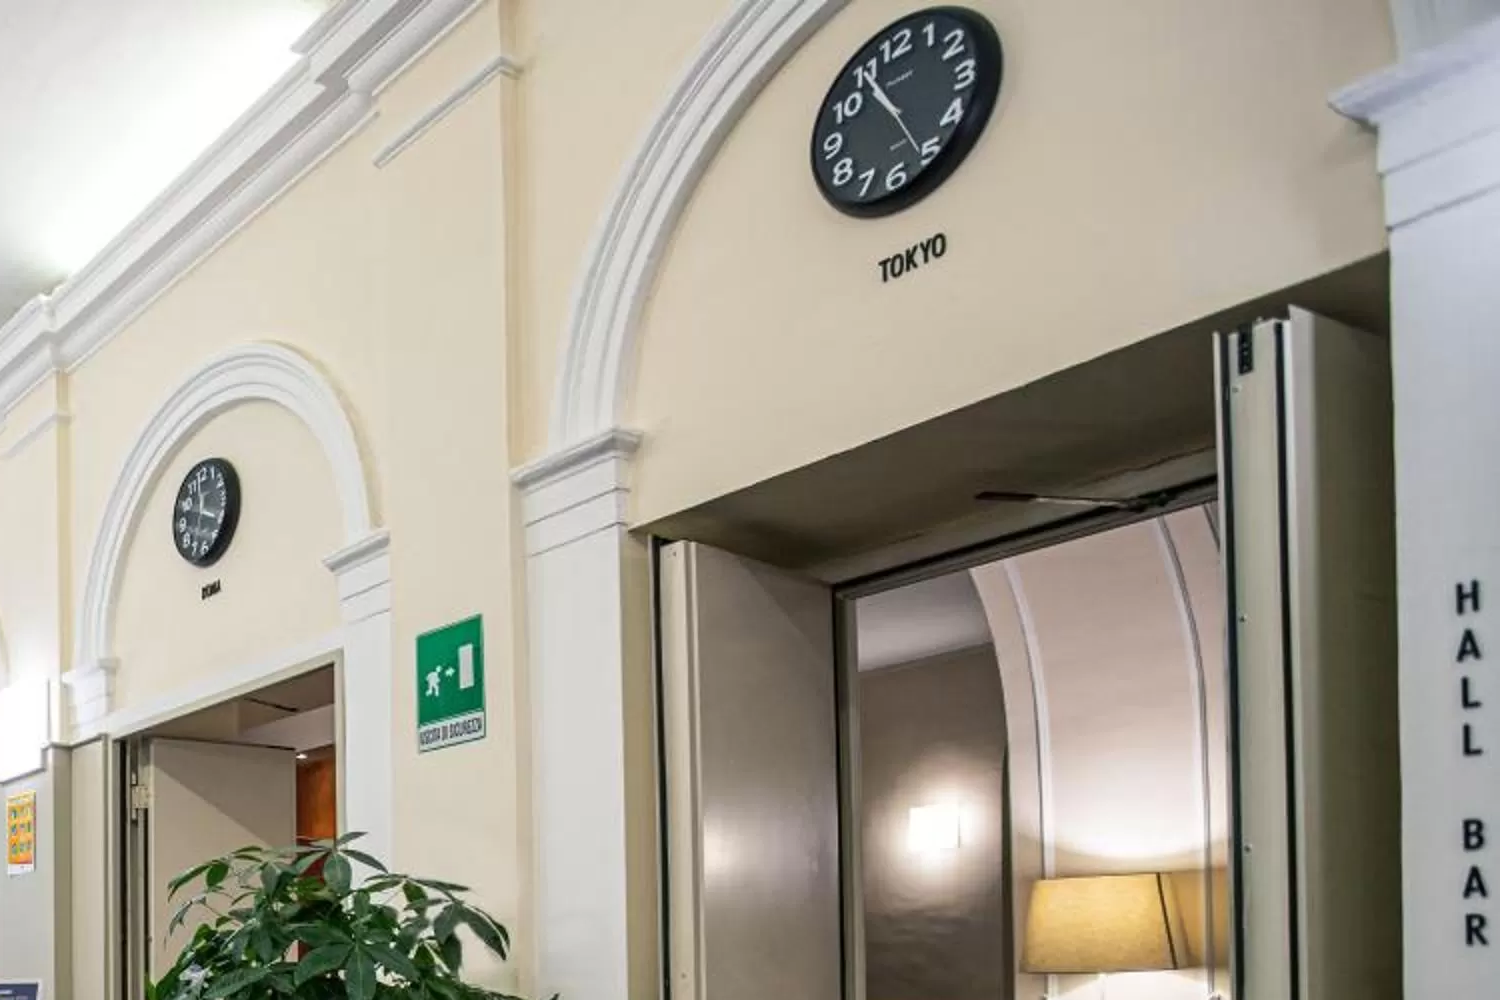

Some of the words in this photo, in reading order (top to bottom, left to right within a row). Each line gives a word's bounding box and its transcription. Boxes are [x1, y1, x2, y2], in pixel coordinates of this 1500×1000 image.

[879, 29, 912, 64] 12
[922, 22, 936, 48] 1
[941, 30, 965, 60] 2
[853, 57, 877, 88] 11
[953, 58, 976, 91] 3
[832, 92, 863, 124] 10
[939, 97, 964, 127] 4
[823, 132, 844, 160] 9
[920, 136, 941, 166] 5
[832, 158, 853, 186] 8
[858, 168, 875, 197] 7
[885, 162, 907, 190] 6
[878, 232, 947, 283] TOKYO
[1454, 579, 1483, 757] HALL
[1462, 817, 1489, 947] BAR
